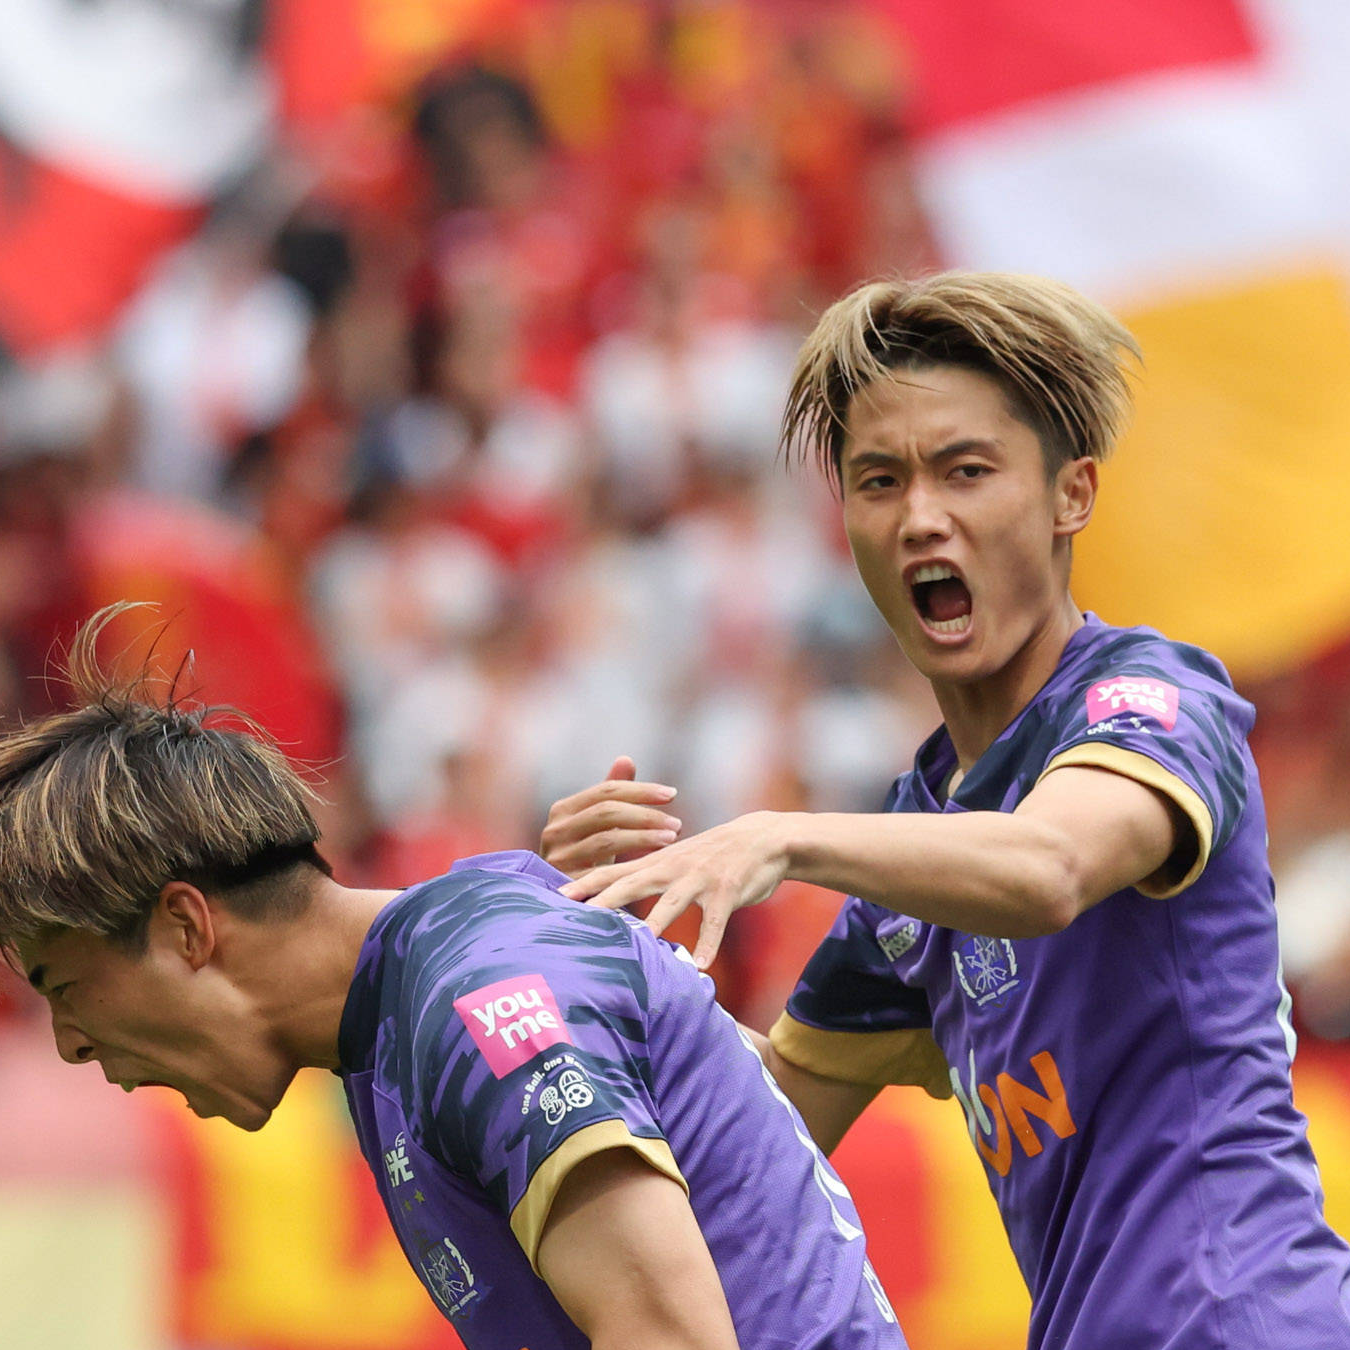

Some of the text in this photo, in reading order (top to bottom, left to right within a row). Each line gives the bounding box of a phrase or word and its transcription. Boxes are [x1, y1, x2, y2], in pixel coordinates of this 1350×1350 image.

[1096, 683, 1164, 702] you
[1111, 693, 1168, 713] me
[471, 989, 544, 1037] you
[498, 1010, 559, 1049] me
[543, 1057, 563, 1071] One
